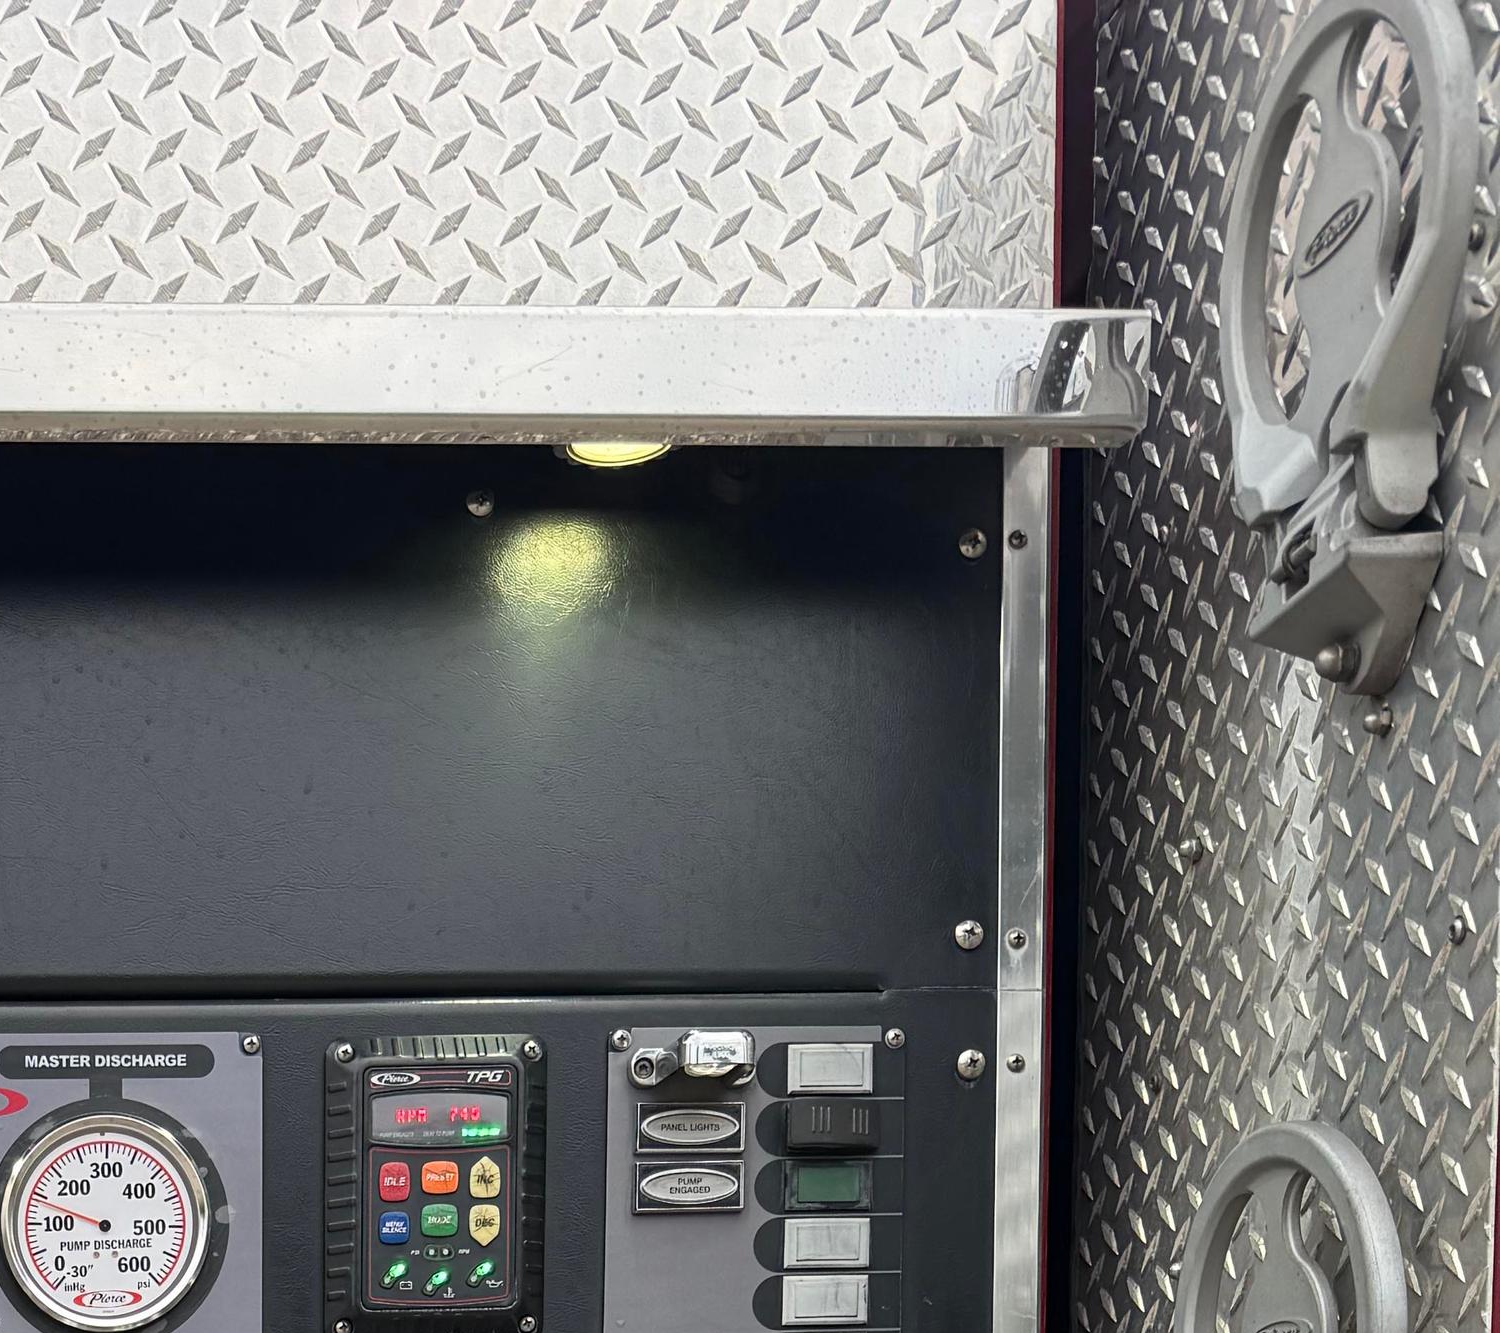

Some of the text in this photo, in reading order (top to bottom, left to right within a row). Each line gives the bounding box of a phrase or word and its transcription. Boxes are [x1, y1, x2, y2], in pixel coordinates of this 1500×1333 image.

[24, 1054, 187, 1068] MASTER DISCHARGE
[466, 1070, 504, 1083] TPG
[660, 1123, 720, 1132] PANEL LIGHTS
[89, 1161, 123, 1179] 300
[56, 1179, 91, 1197] 200
[383, 1176, 406, 1186] IDLE
[677, 1177, 703, 1186] PUMP
[122, 1182, 156, 1200] 400
[669, 1185, 711, 1195] ENGAGED
[43, 1215, 75, 1233] 100
[132, 1218, 167, 1236] 500
[59, 1238, 153, 1252] PUMP DISCHARGE
[54, 1255, 66, 1272] 0
[117, 1256, 151, 1273] 600
